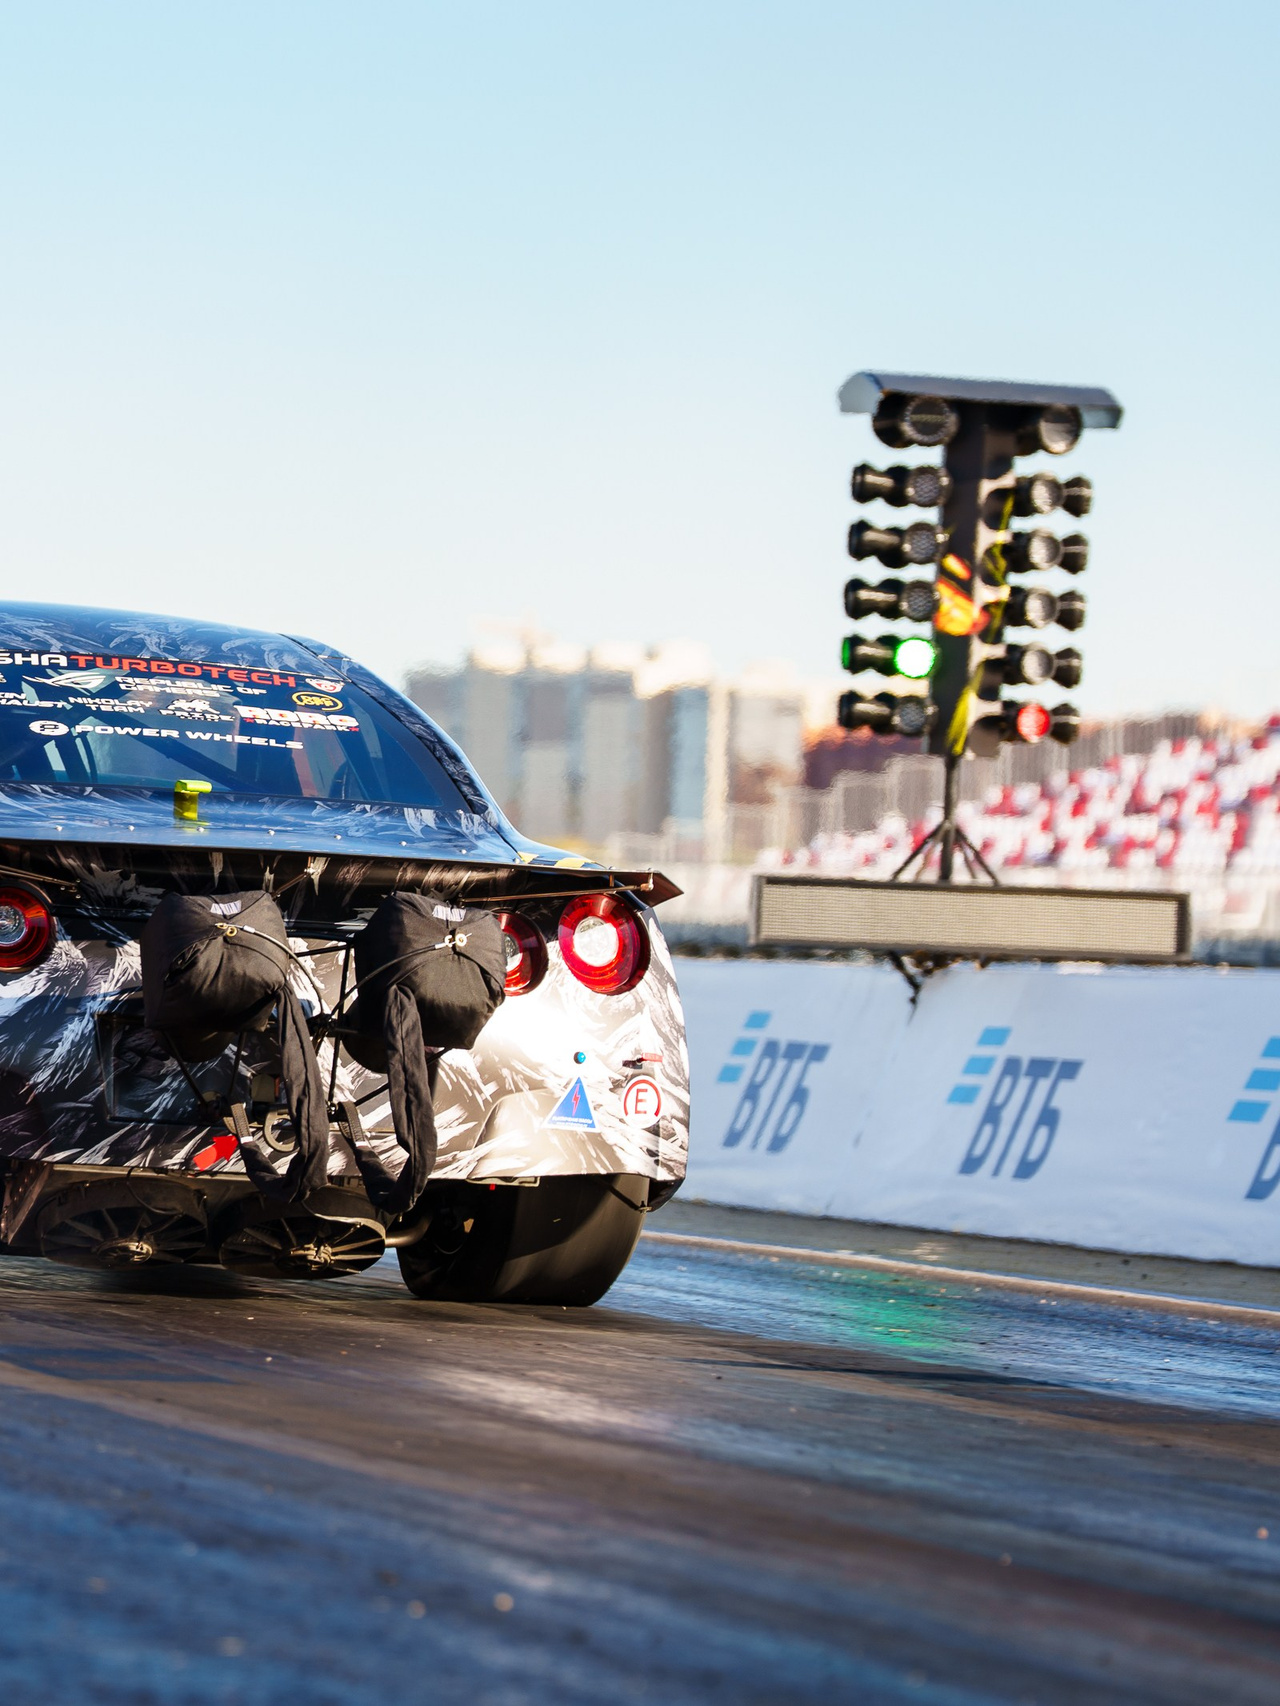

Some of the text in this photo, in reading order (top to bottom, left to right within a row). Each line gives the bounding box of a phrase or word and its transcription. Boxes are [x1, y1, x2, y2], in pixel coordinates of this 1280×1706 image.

[115, 676, 267, 695] REPUBLIC OF
[119, 684, 220, 698] GAMERS
[68, 697, 152, 707] NIKOLAY
[86, 704, 145, 713] TEAM
[159, 709, 236, 721] PRIDE
[233, 705, 359, 727] RDRC
[75, 725, 303, 749] POWER WHEELS
[634, 1088, 648, 1114] E
[722, 1037, 831, 1155] ВТБ
[958, 1055, 1084, 1181] ВТБ
